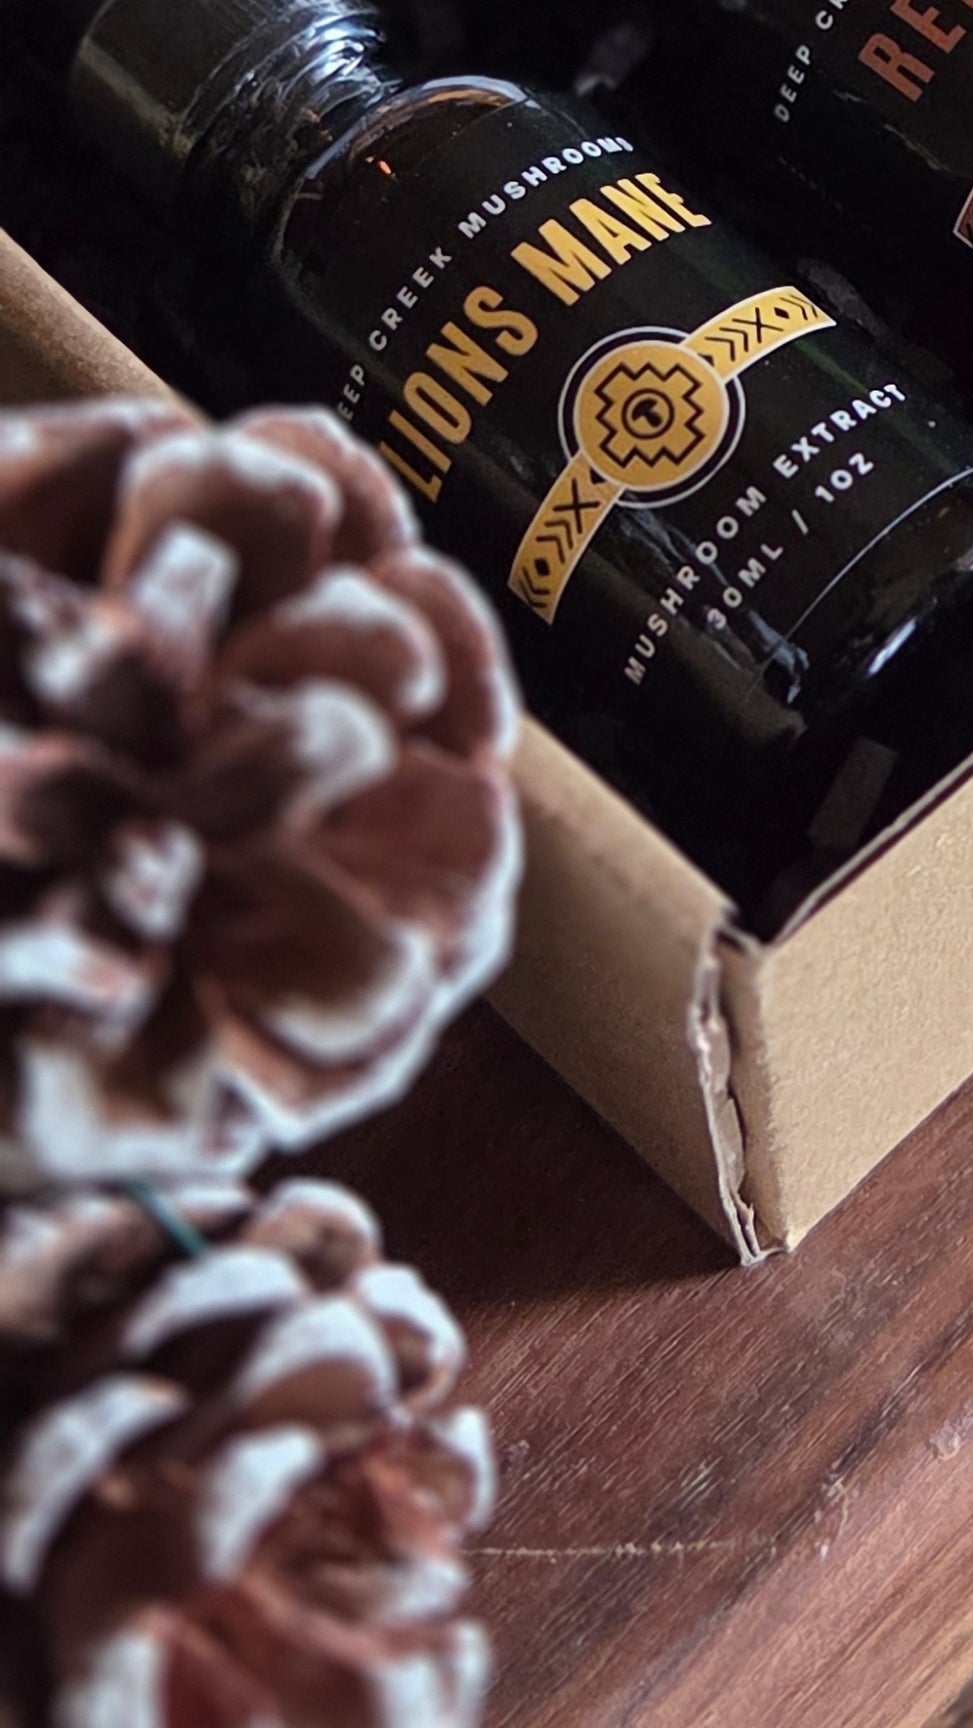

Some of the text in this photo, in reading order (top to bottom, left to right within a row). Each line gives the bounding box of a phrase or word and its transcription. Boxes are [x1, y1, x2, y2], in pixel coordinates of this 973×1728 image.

[774, 44, 812, 123] DEEP
[337, 364, 366, 422] EEP
[368, 246, 453, 352] CREEK
[376, 172, 713, 504] LIONS MANE
[624, 383, 906, 686] MUSHROOM EXTRACT
[706, 453, 874, 630] 30ML / 1OZ
